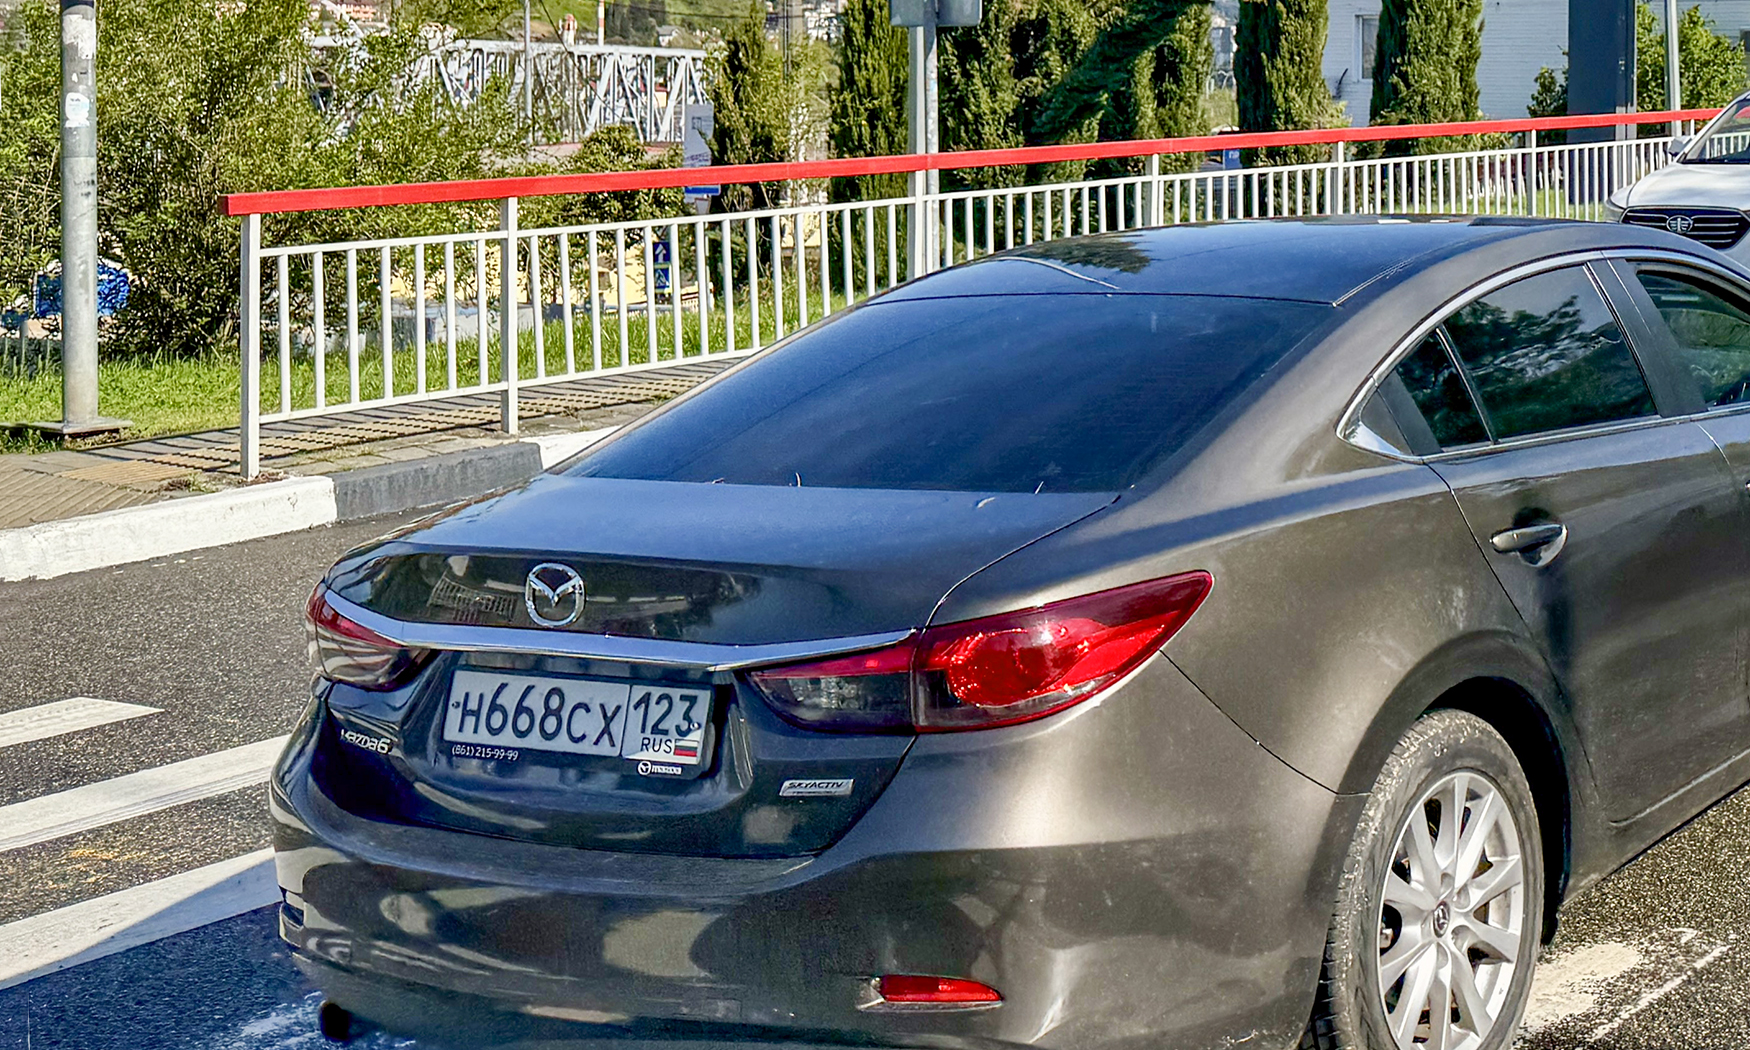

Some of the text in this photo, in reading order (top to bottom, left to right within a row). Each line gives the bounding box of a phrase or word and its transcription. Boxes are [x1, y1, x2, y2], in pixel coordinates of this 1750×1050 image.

[632, 691, 699, 738] 123
[451, 744, 519, 762] (861) 215-99-99
[640, 737, 673, 754] RUS
[787, 781, 845, 789] SKYACTIV
